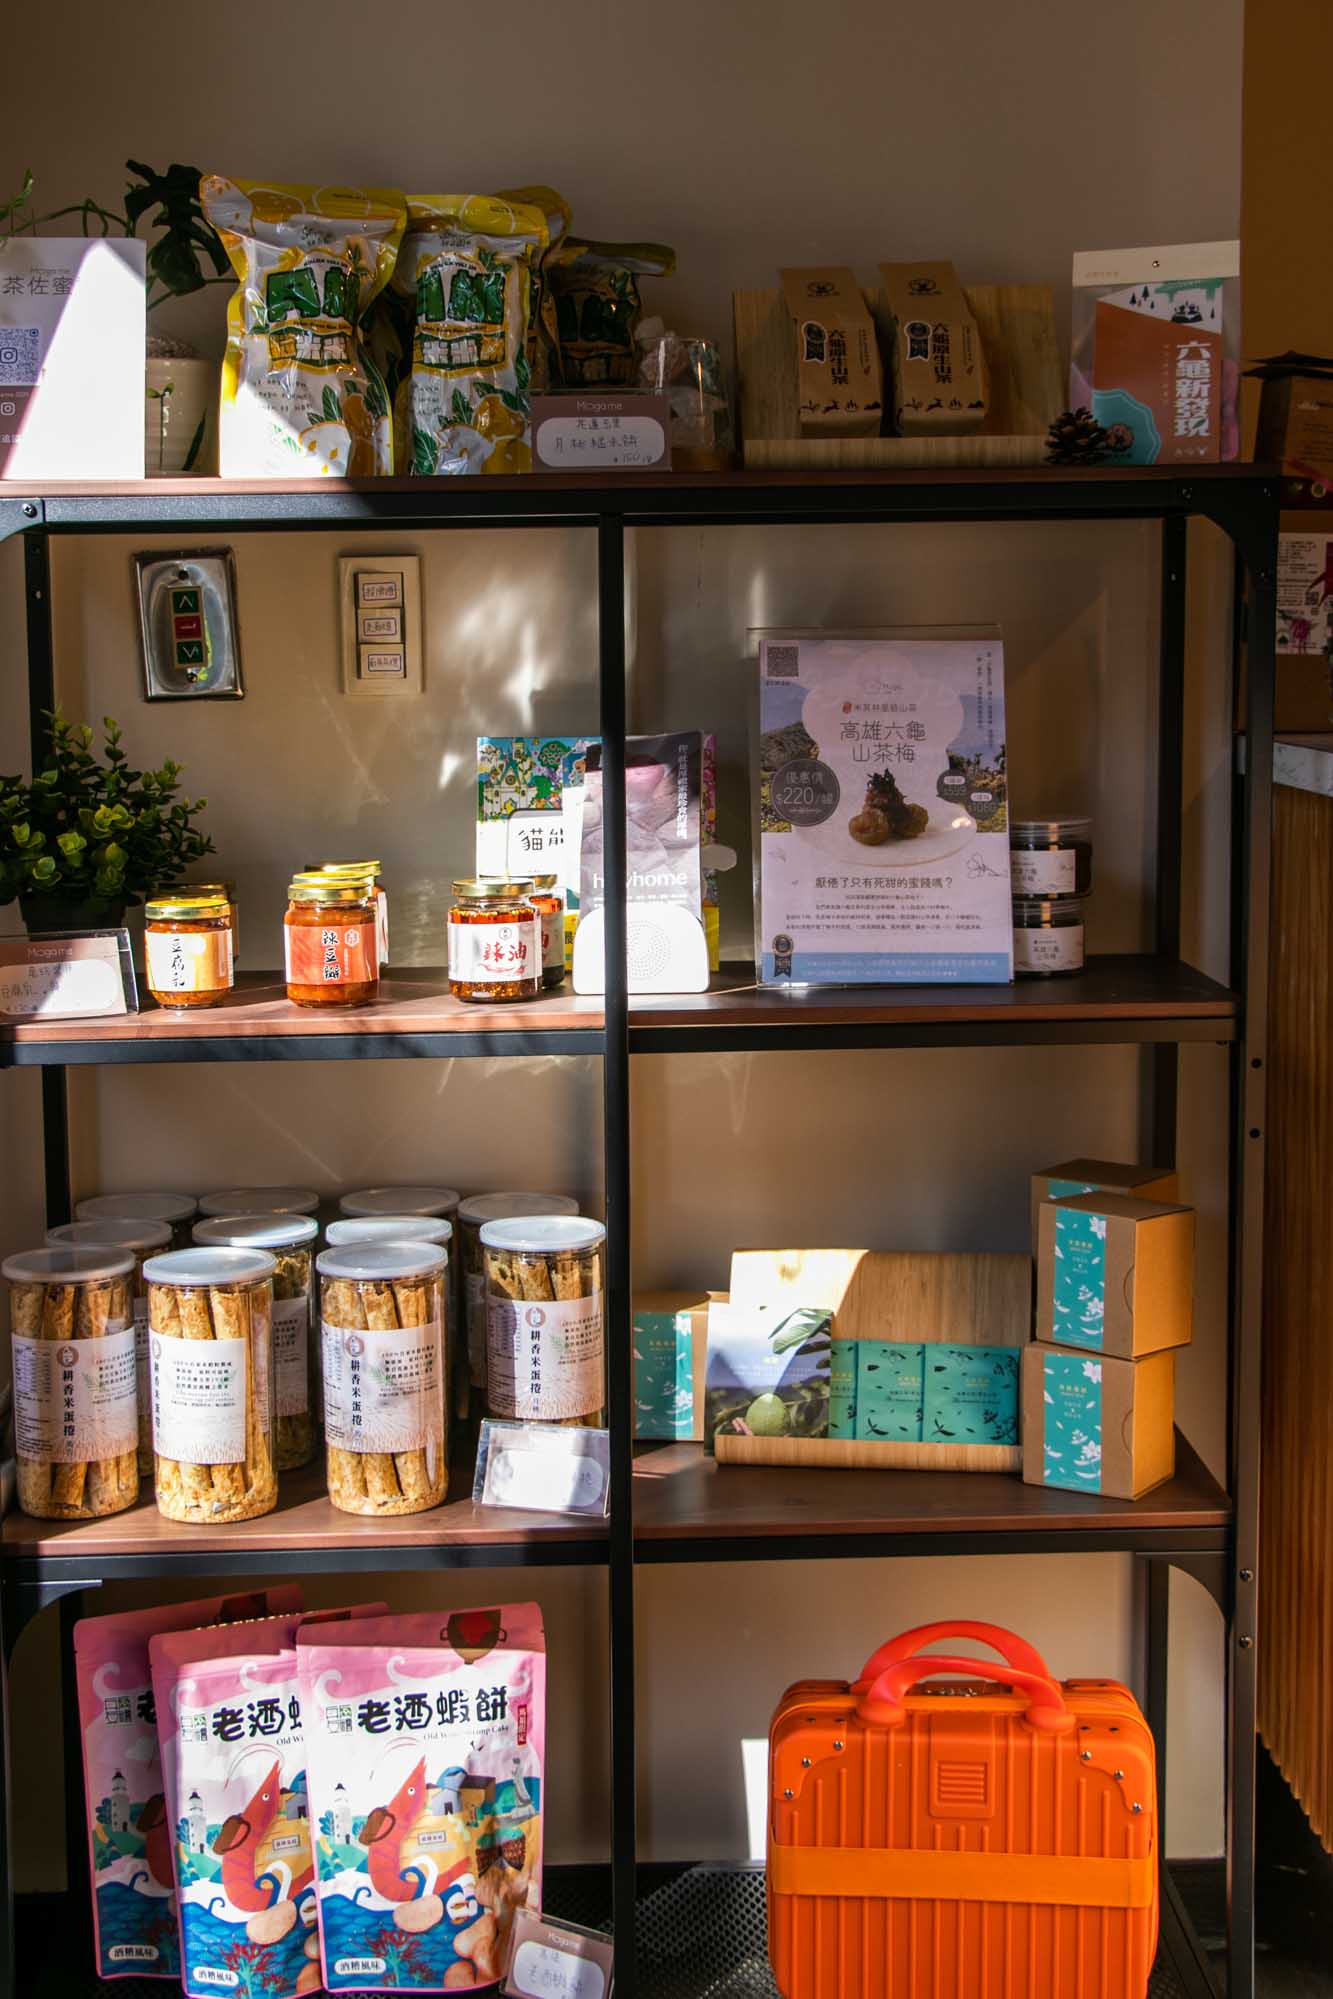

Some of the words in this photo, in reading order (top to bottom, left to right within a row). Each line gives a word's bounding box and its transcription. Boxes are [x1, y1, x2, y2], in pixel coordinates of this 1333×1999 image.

[2, 276, 73, 296] 茶佐蜜
[1174, 340, 1212, 438] 六龜新發現
[839, 720, 928, 742] 高雄六龜
[852, 743, 917, 763] 山茶梅
[357, 1686, 508, 1734] 老酒蝦餅
